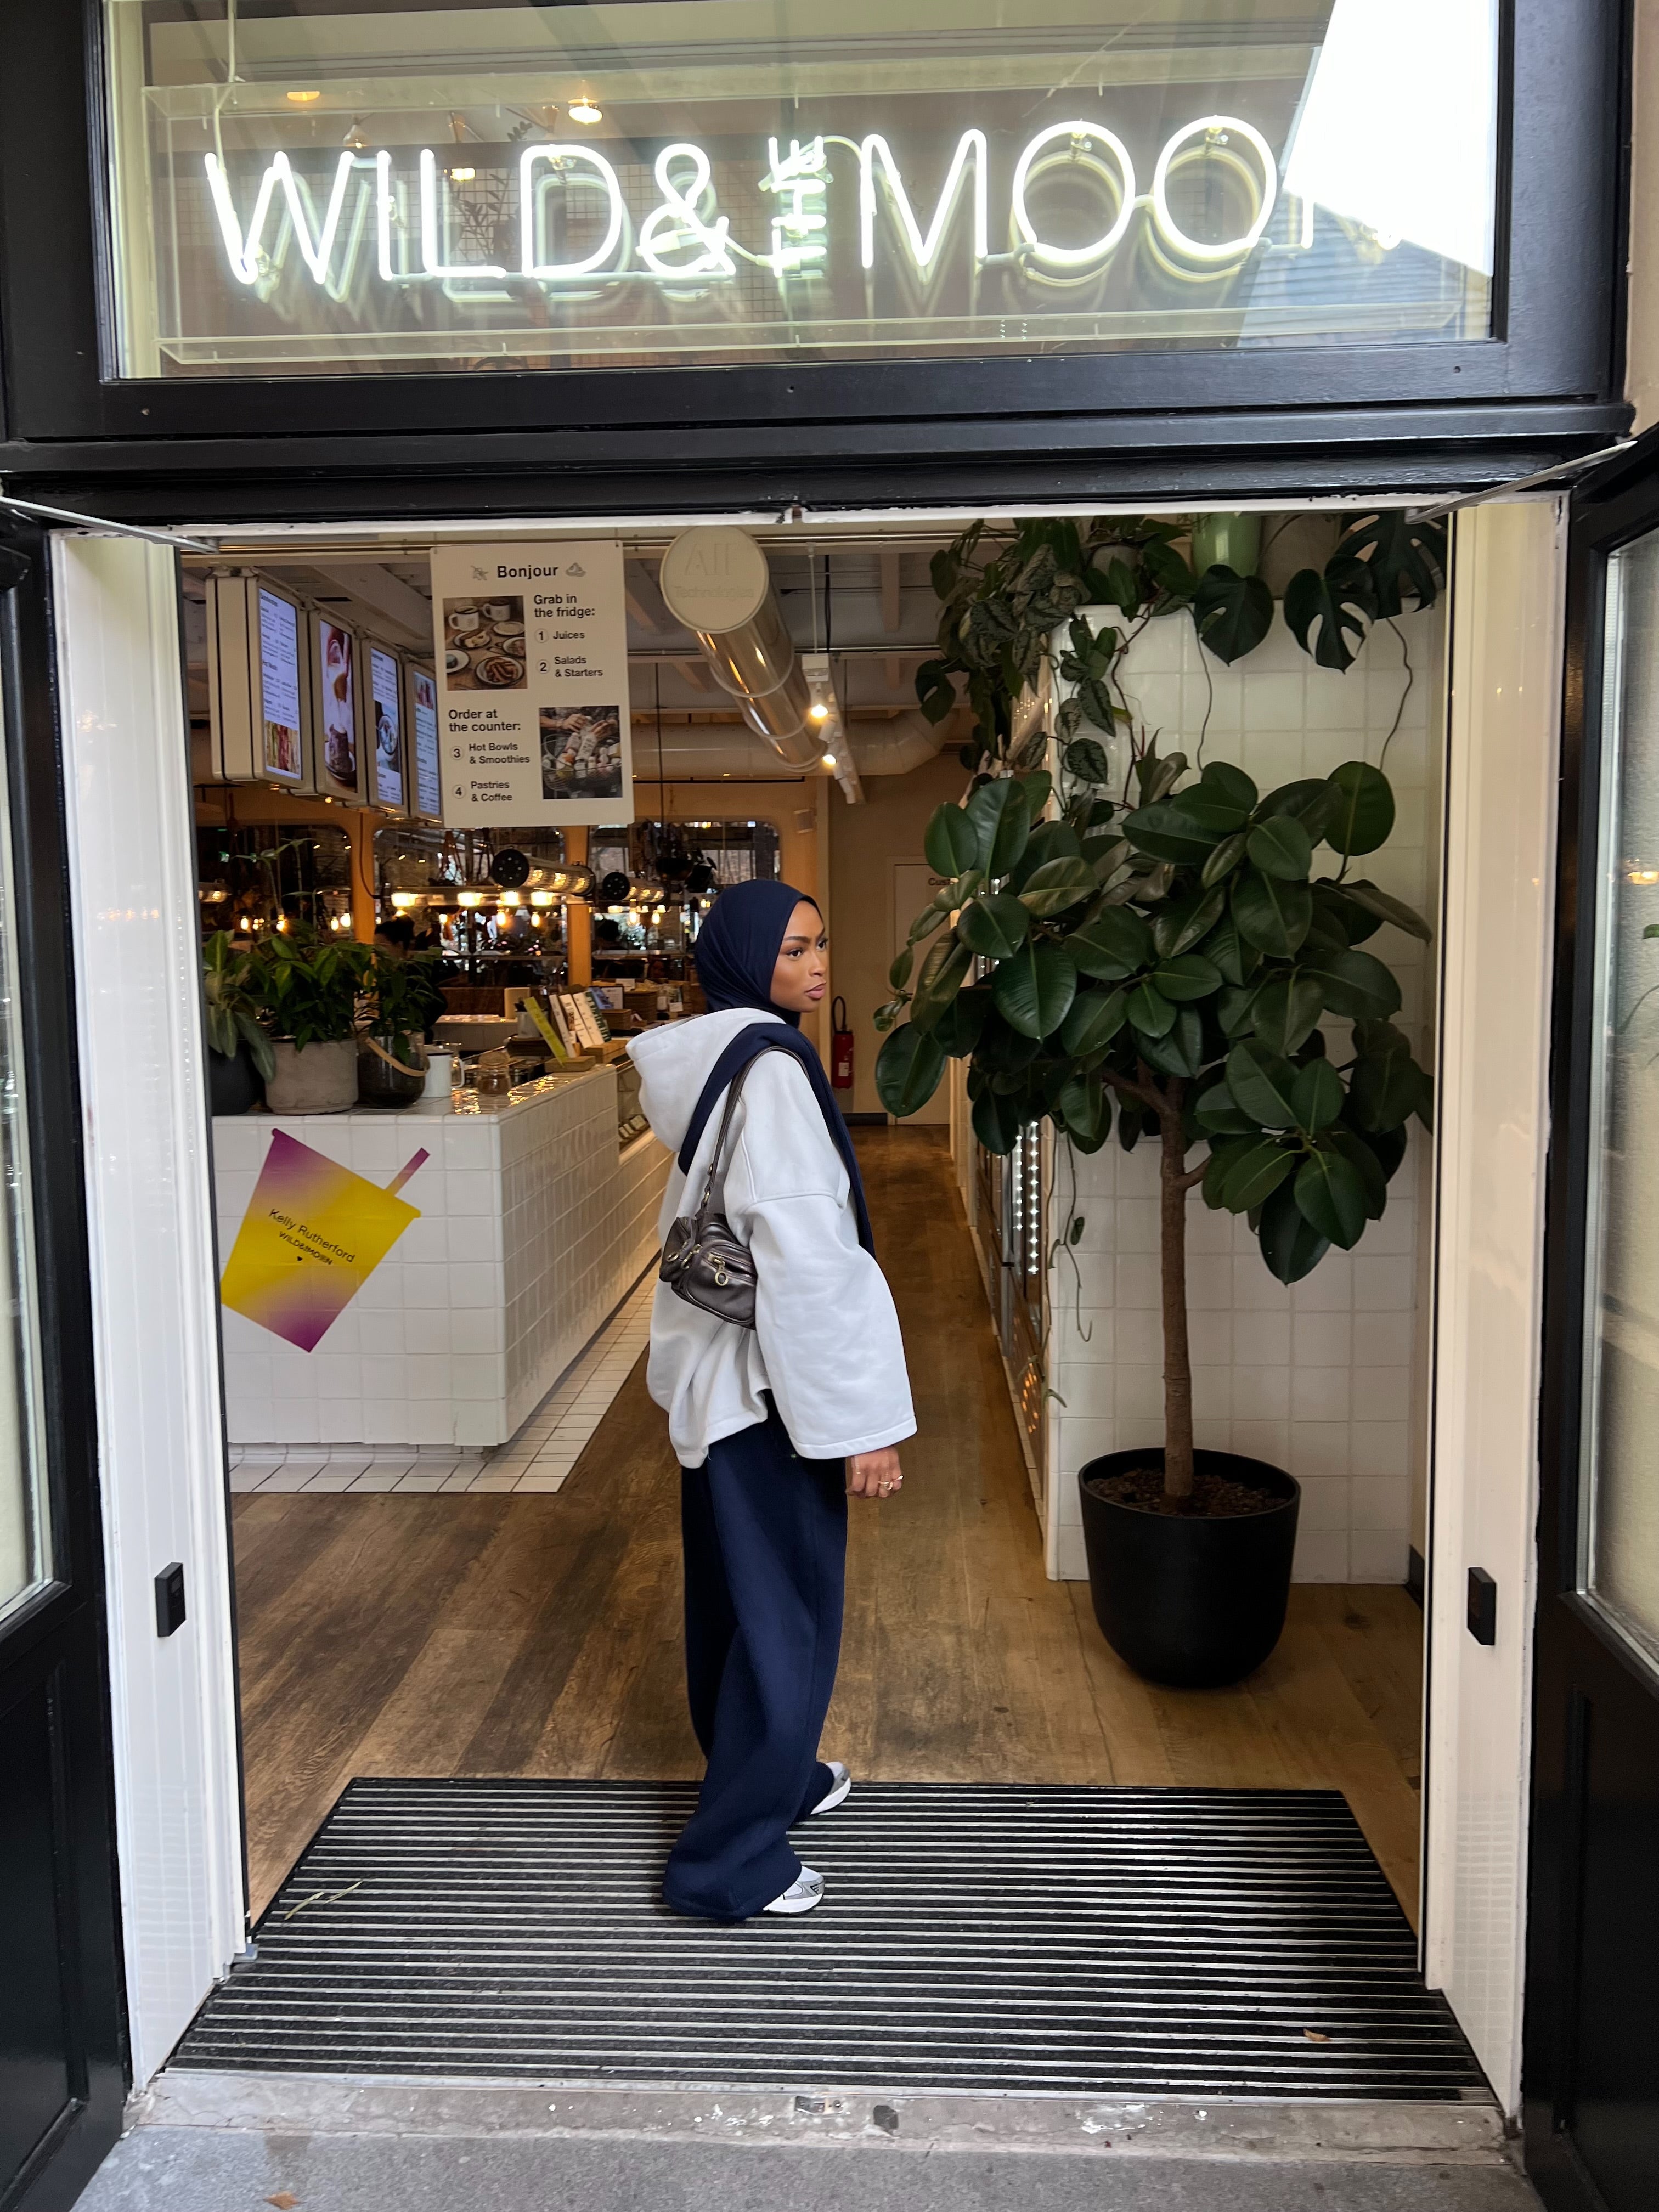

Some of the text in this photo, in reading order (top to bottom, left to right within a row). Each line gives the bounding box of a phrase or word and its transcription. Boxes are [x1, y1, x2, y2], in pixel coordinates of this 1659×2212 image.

[497, 565, 558, 579] Bonjour
[533, 594, 578, 605] Grab in
[534, 606, 595, 618] the fridge:
[552, 631, 585, 640] Juices
[554, 656, 587, 665] Salads
[555, 668, 603, 678] & Starters
[448, 709, 498, 719] Order at
[449, 721, 521, 732] the counter:
[469, 743, 487, 752] Hot
[488, 742, 518, 751] Bowls
[469, 755, 531, 764] & Smoothies
[470, 781, 510, 789] Pastries
[471, 793, 513, 802] & Coffee
[268, 1209, 356, 1262] Kelly Rutherford
